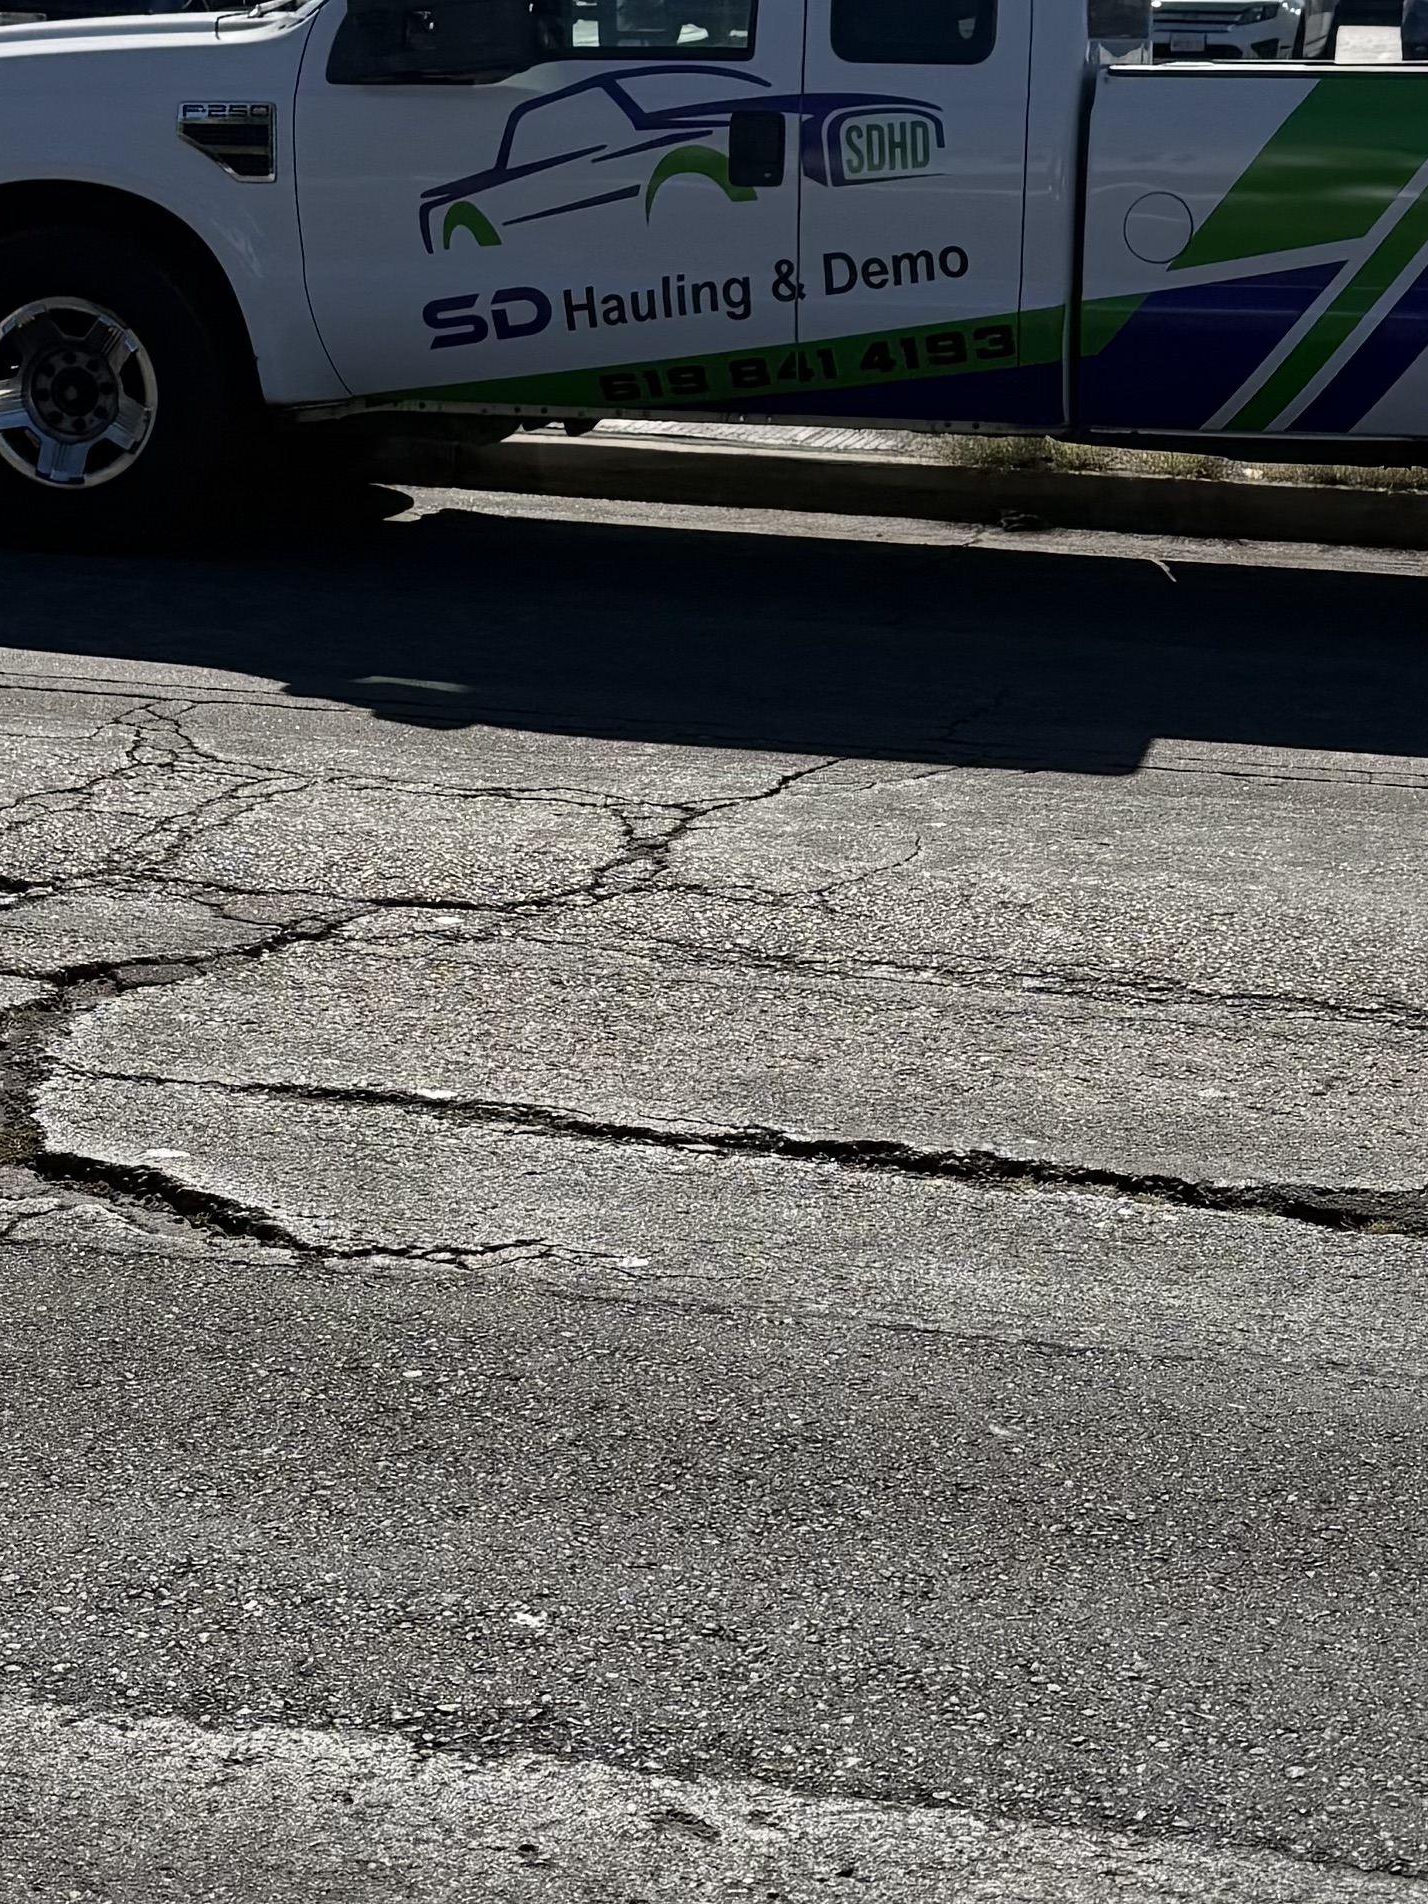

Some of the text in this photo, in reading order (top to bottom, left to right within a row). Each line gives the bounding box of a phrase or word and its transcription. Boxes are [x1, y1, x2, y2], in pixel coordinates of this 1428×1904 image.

[845, 119, 931, 176] SDHD
[422, 245, 970, 351] SD Hauling & Demo
[598, 325, 1018, 402] 619 841 4193
